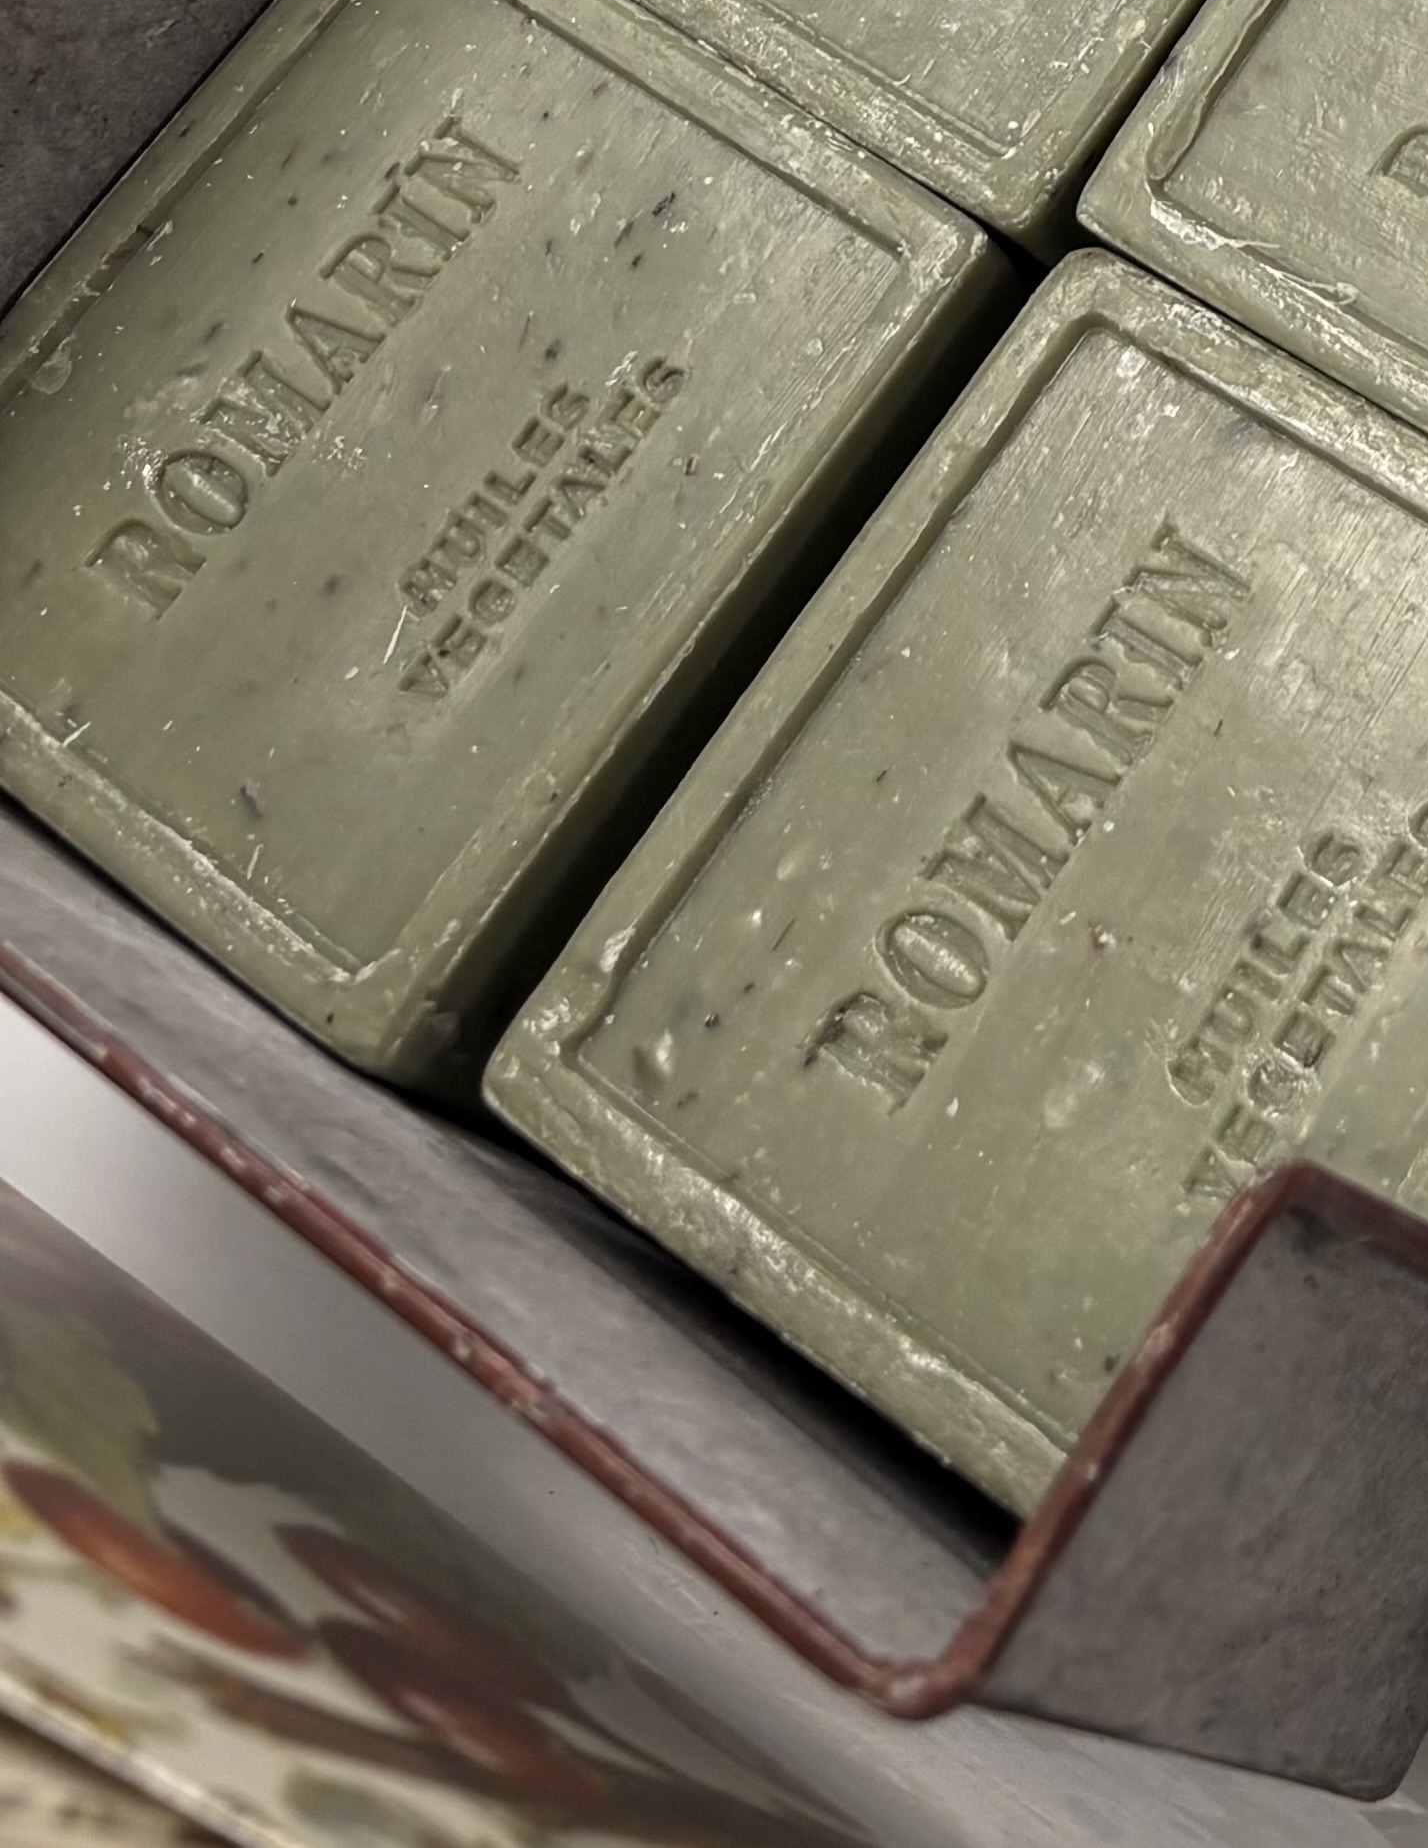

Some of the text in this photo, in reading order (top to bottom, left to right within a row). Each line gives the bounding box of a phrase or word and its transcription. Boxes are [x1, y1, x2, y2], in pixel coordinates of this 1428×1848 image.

[82, 114, 522, 621] ROMARIN
[401, 383, 590, 623] HUILES
[402, 352, 690, 699] VEGETALES
[801, 514, 1256, 1113] ROMARIN
[1167, 830, 1364, 1108] HUILES
